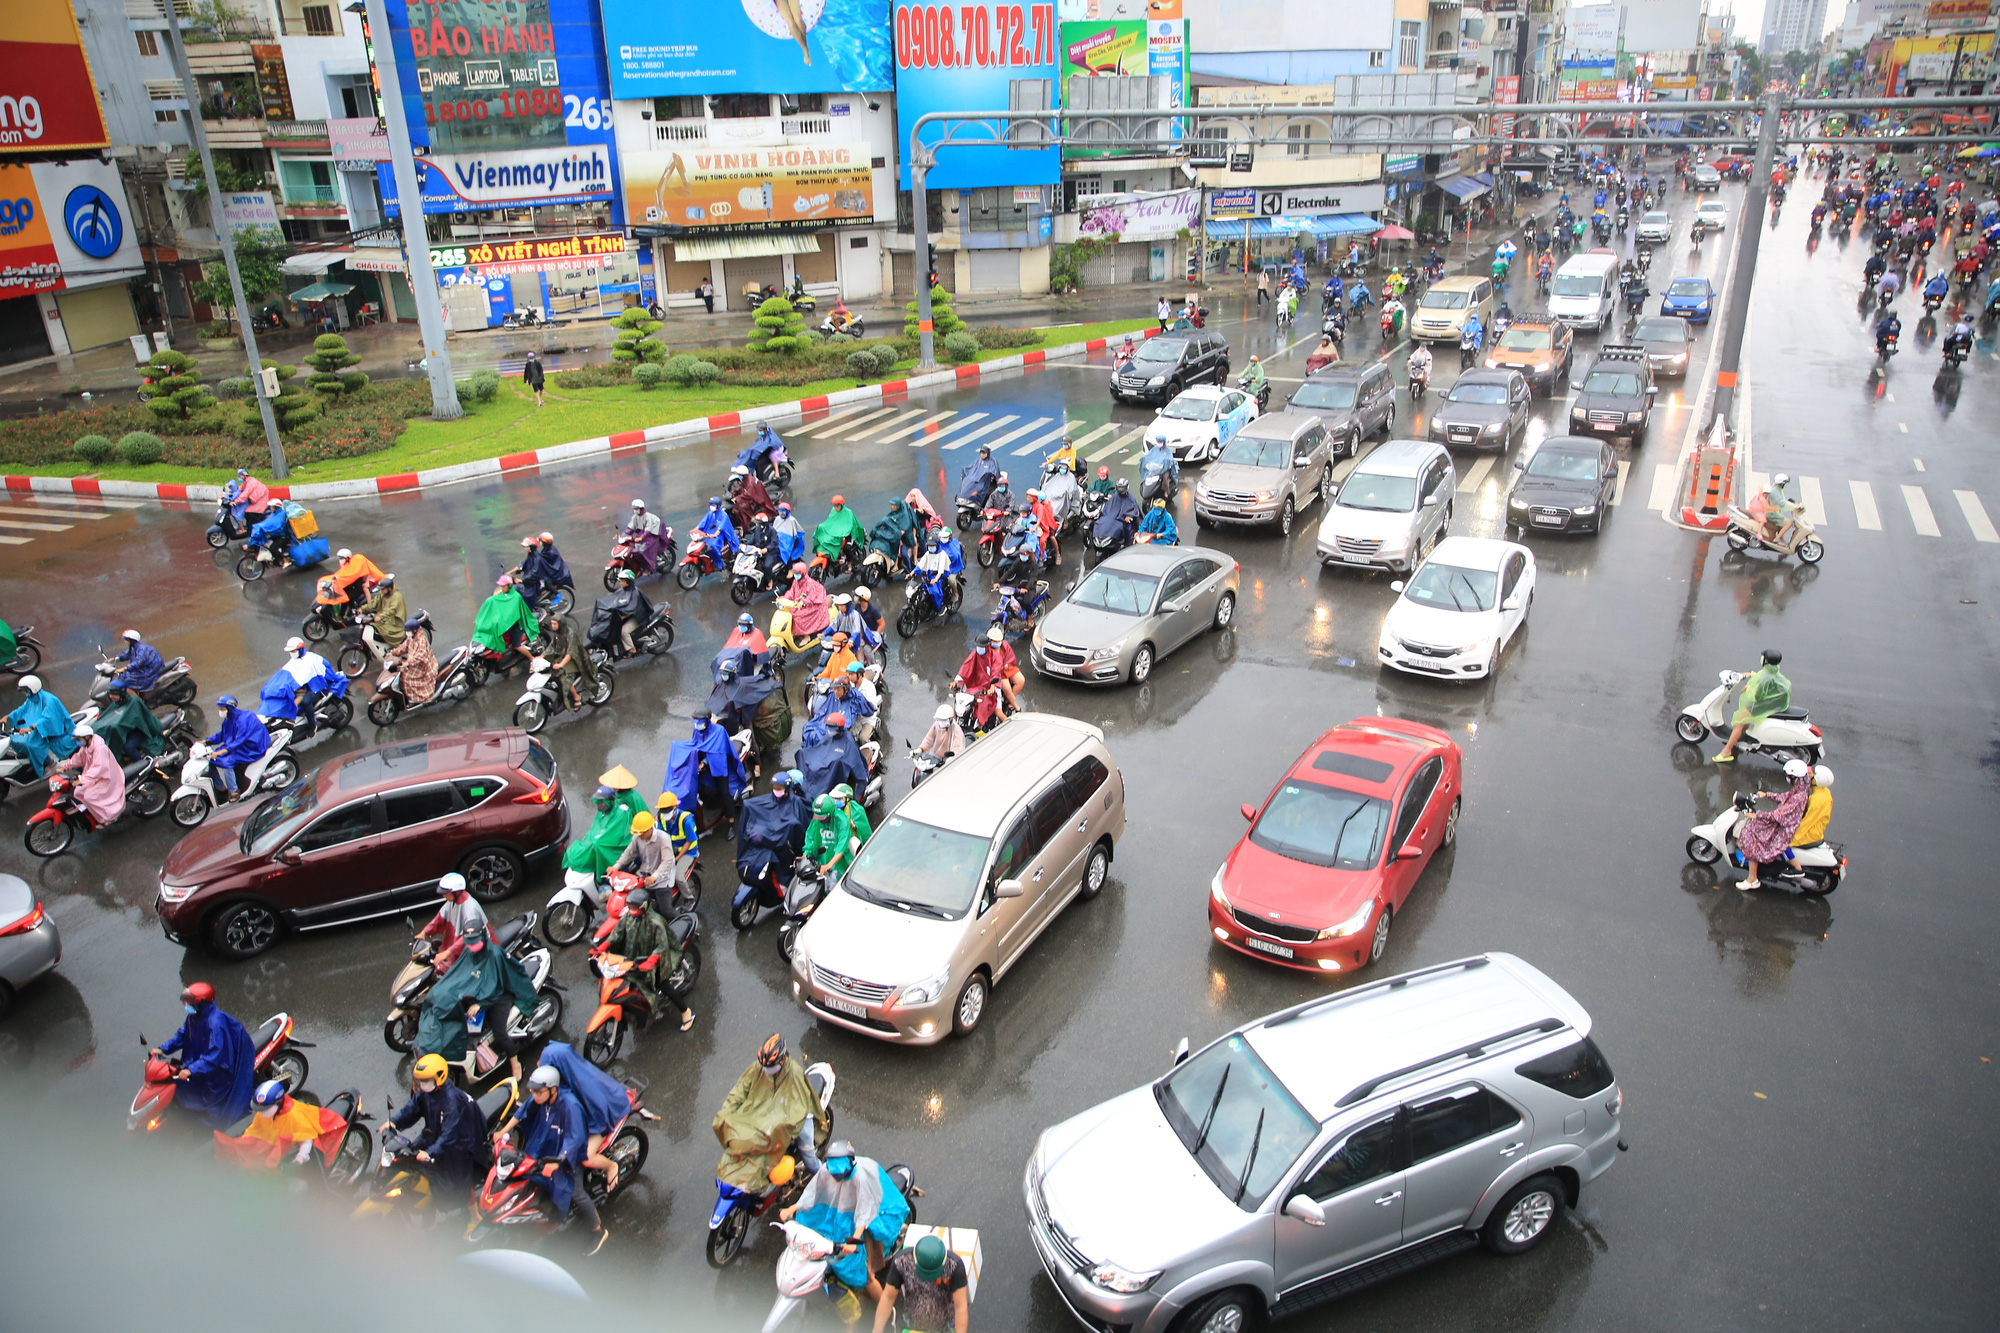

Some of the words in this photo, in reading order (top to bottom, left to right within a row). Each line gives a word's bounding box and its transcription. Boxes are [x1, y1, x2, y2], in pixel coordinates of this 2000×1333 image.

[410, 6, 471, 57] BẢO
[481, 14, 555, 54] HÀNH
[896, 4, 1054, 69] 0908.70.72.71
[1149, 36, 1181, 45] MOSFLY
[433, 71, 460, 86] PHONE
[468, 69, 500, 84] LAPTOP
[510, 68, 538, 82] TABLET
[623, 69, 737, 79] Reservations@thegrandhotram.com
[424, 99, 488, 123] 1800
[499, 88, 563, 118] 1080
[564, 94, 614, 131] 265
[696, 153, 758, 170] VINH
[767, 147, 850, 167] HOÀNG
[455, 151, 604, 191] Vienmaytinh
[580, 183, 605, 192] .com
[232, 196, 253, 204] DNTN
[253, 196, 264, 204] TM
[424, 194, 459, 203] Computer
[454, 202, 468, 210] 265
[1287, 196, 1341, 210] Electrolux
[431, 248, 467, 267] 265
[468, 243, 493, 264] XÔ
[495, 240, 533, 260] VIẾT
[537, 236, 581, 257] NGHỆ
[583, 236, 624, 254] TĨNH
[486, 264, 500, 276] ĐỔI
[501, 263, 517, 274] MÀN
[518, 262, 536, 273] HÌNH
[537, 264, 542, 272] &
[543, 263, 556, 271] SSD
[557, 260, 572, 270] MỚI
[573, 258, 582, 269] BÙ
[583, 259, 600, 269] 100K
[565, 272, 582, 280] ASUS
